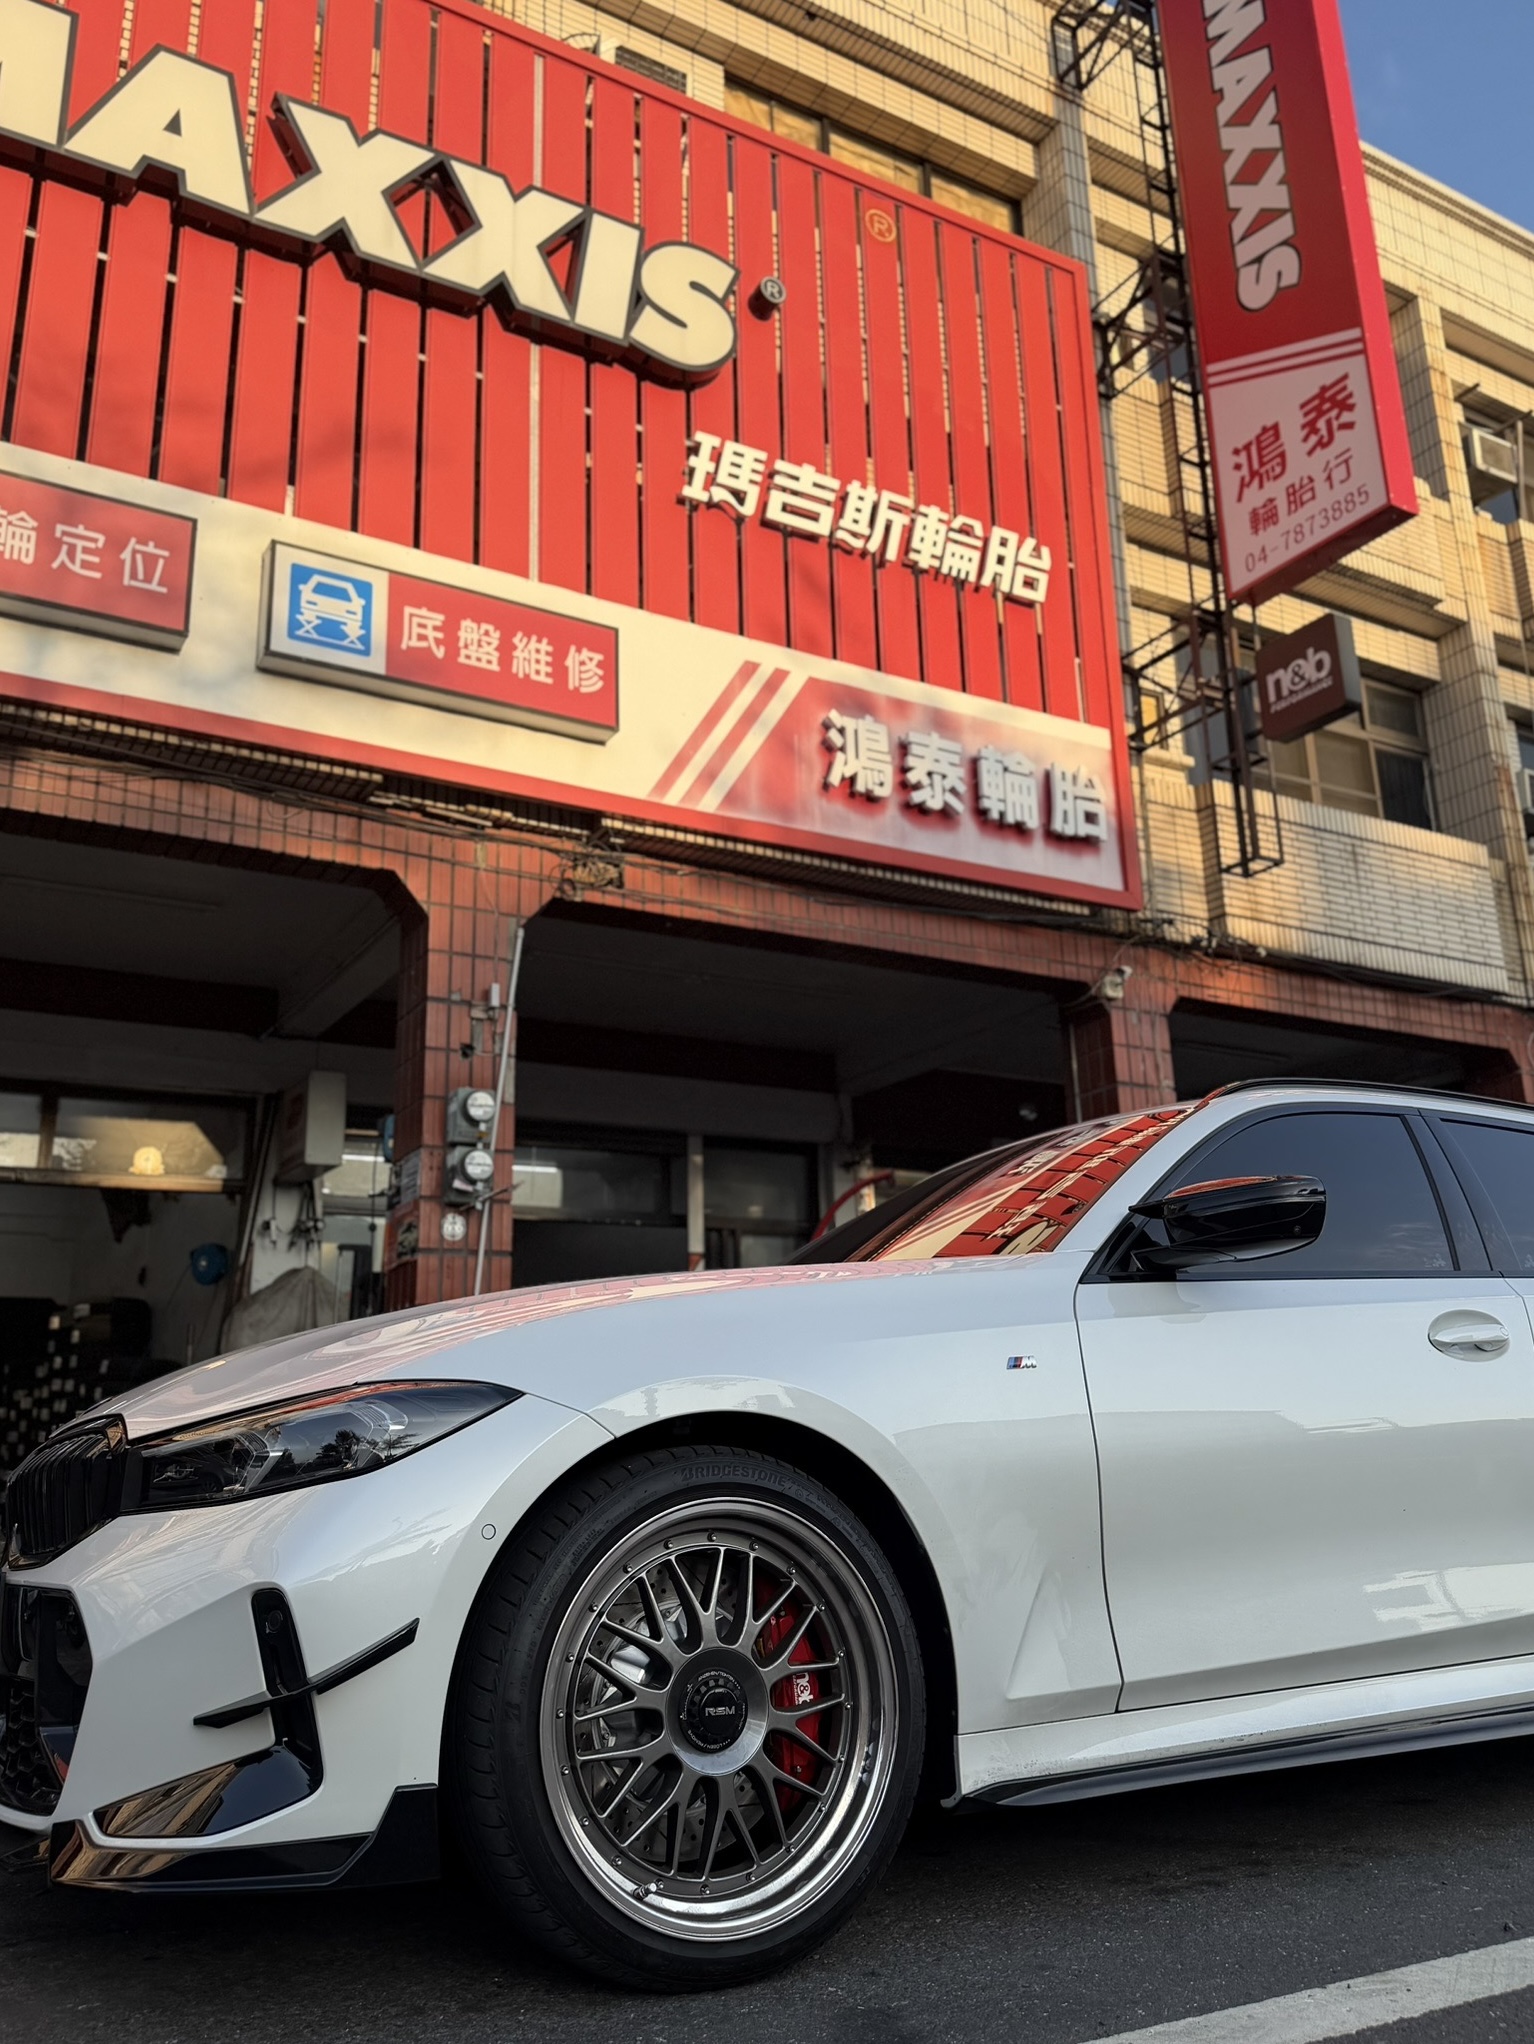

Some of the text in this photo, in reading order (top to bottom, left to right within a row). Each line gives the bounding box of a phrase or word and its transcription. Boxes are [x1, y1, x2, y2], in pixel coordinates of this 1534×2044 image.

[1232, 371, 1357, 503] 鴻泰
[680, 430, 1052, 604] 瑪吉斯輪胎
[1244, 483, 1370, 572] 04-7873885
[1248, 447, 1353, 537] 輪胎行
[400, 604, 605, 694] 底盤維修
[822, 707, 1109, 842] 鴻泰輪胎
[680, 1463, 790, 1489] BRIDGESTONE
[705, 1705, 736, 1717] RSM
